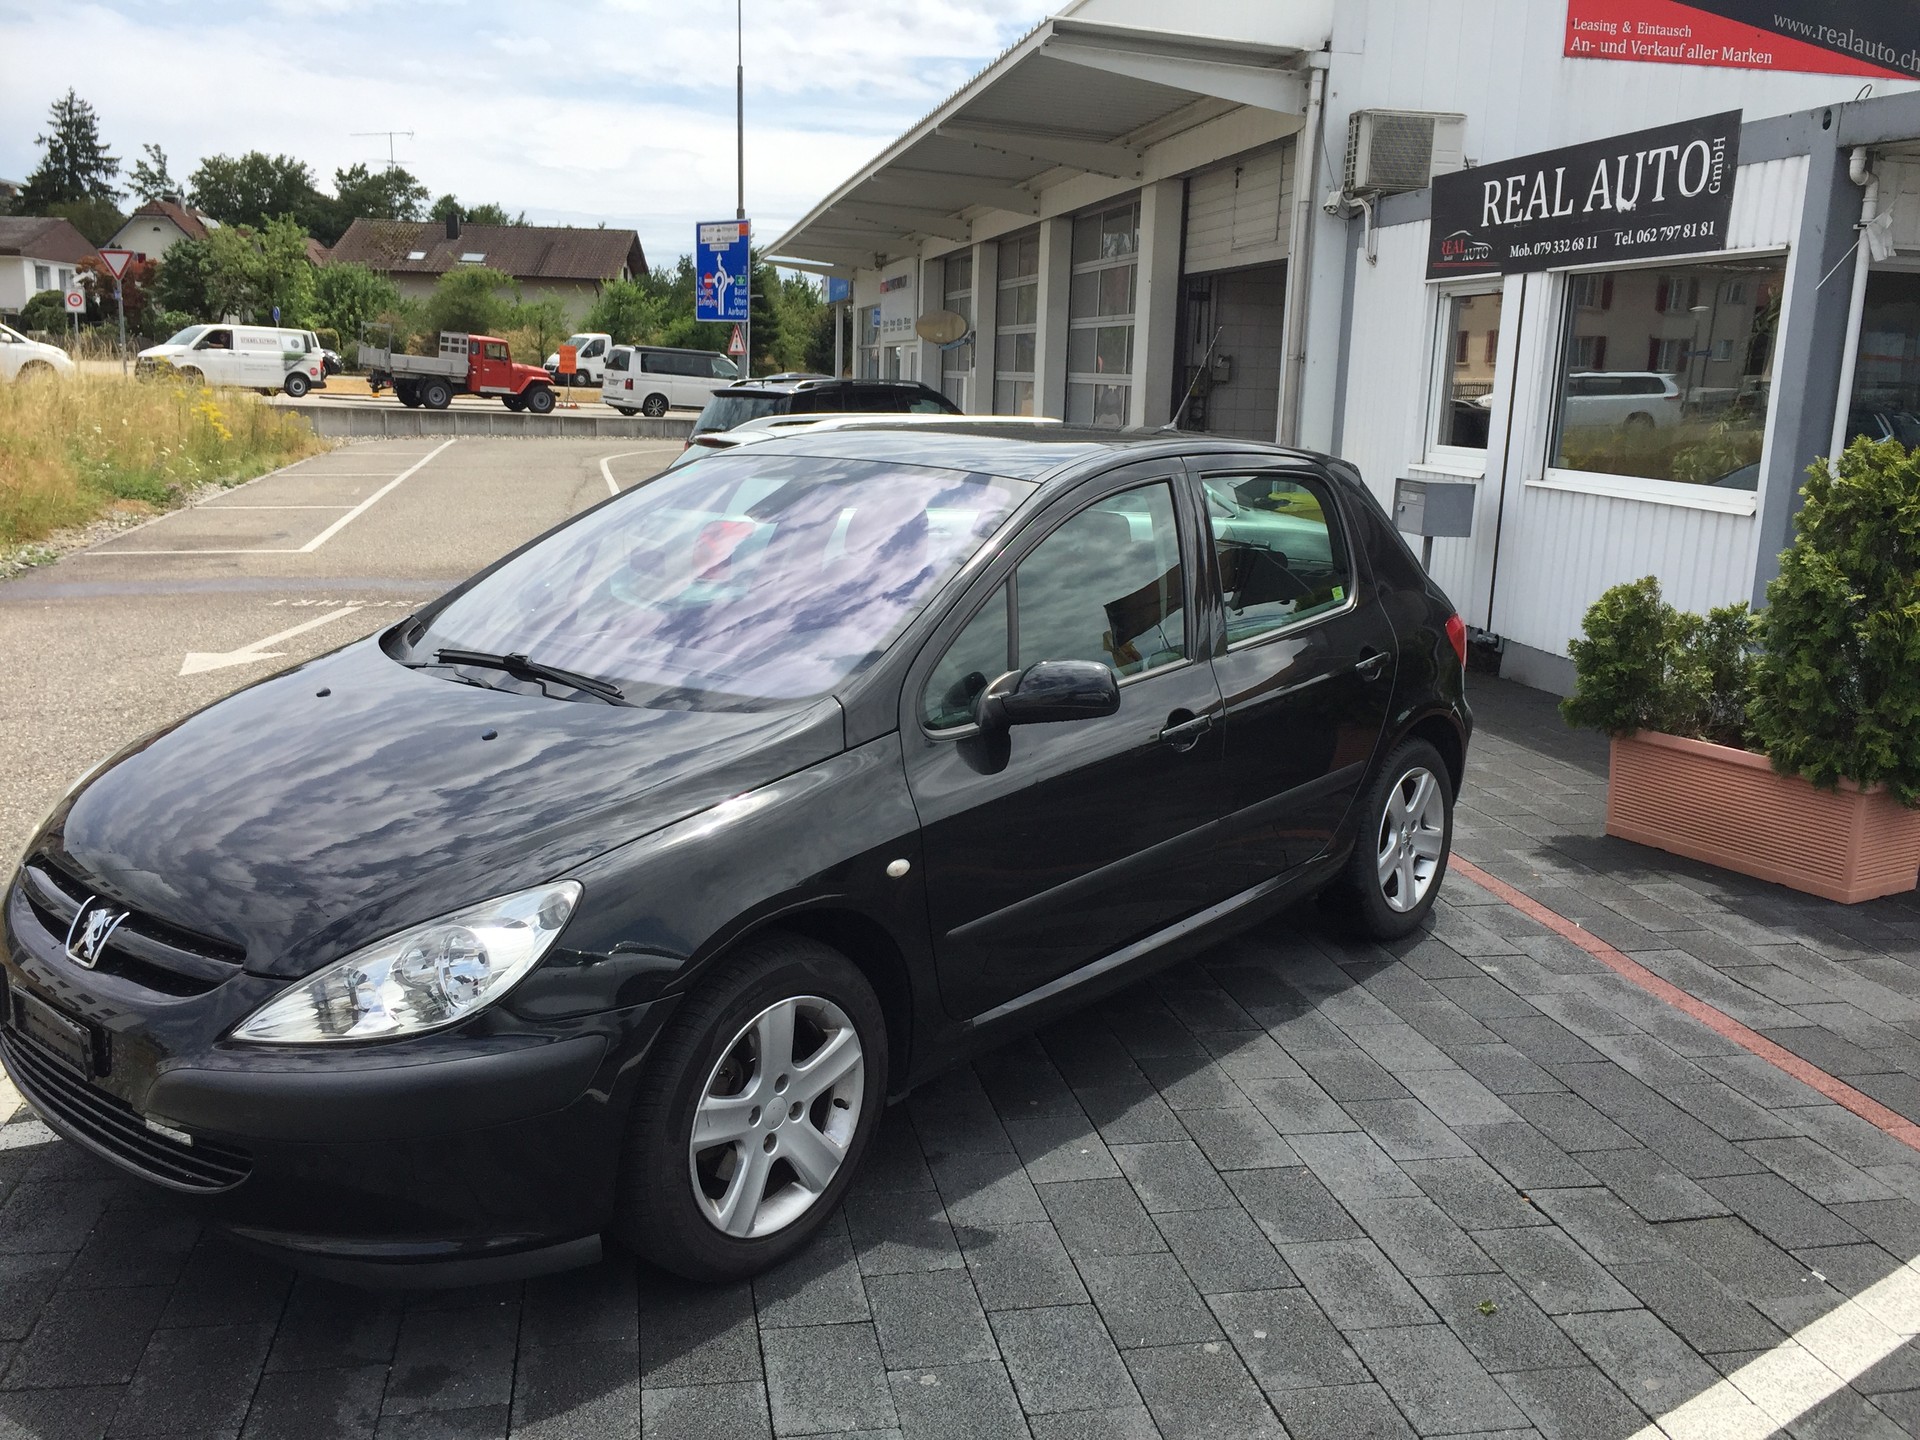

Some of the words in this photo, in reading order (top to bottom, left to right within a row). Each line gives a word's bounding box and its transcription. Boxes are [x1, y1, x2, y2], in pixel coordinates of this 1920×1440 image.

[1573, 17, 1617, 34] Leasing
[1622, 21, 1632, 33] &
[1637, 22, 1692, 38] Eintausch
[1570, 36, 1596, 52] An-
[1600, 39, 1627, 54] und
[1630, 40, 1686, 59] Verkauf
[1687, 43, 1719, 61] aller
[1721, 46, 1773, 64] Marken
[1773, 14, 1920, 73] www.realauto.ch
[1708, 137, 1726, 194] GmbH
[1481, 167, 1574, 227] REAL
[1582, 140, 1711, 213] AUTO
[1614, 230, 1634, 246] Tel.
[1636, 228, 1657, 243] 062
[1659, 225, 1682, 241] 797
[1683, 223, 1697, 238] 81
[1700, 221, 1714, 236] 81
[1441, 239, 1466, 255] REAL
[1462, 246, 1489, 261] AUTO
[1509, 243, 1532, 258] Mob.
[1533, 242, 1552, 256] 079
[1552, 239, 1571, 254] 332
[1571, 237, 1584, 251] 68
[1586, 236, 1598, 249] 11
